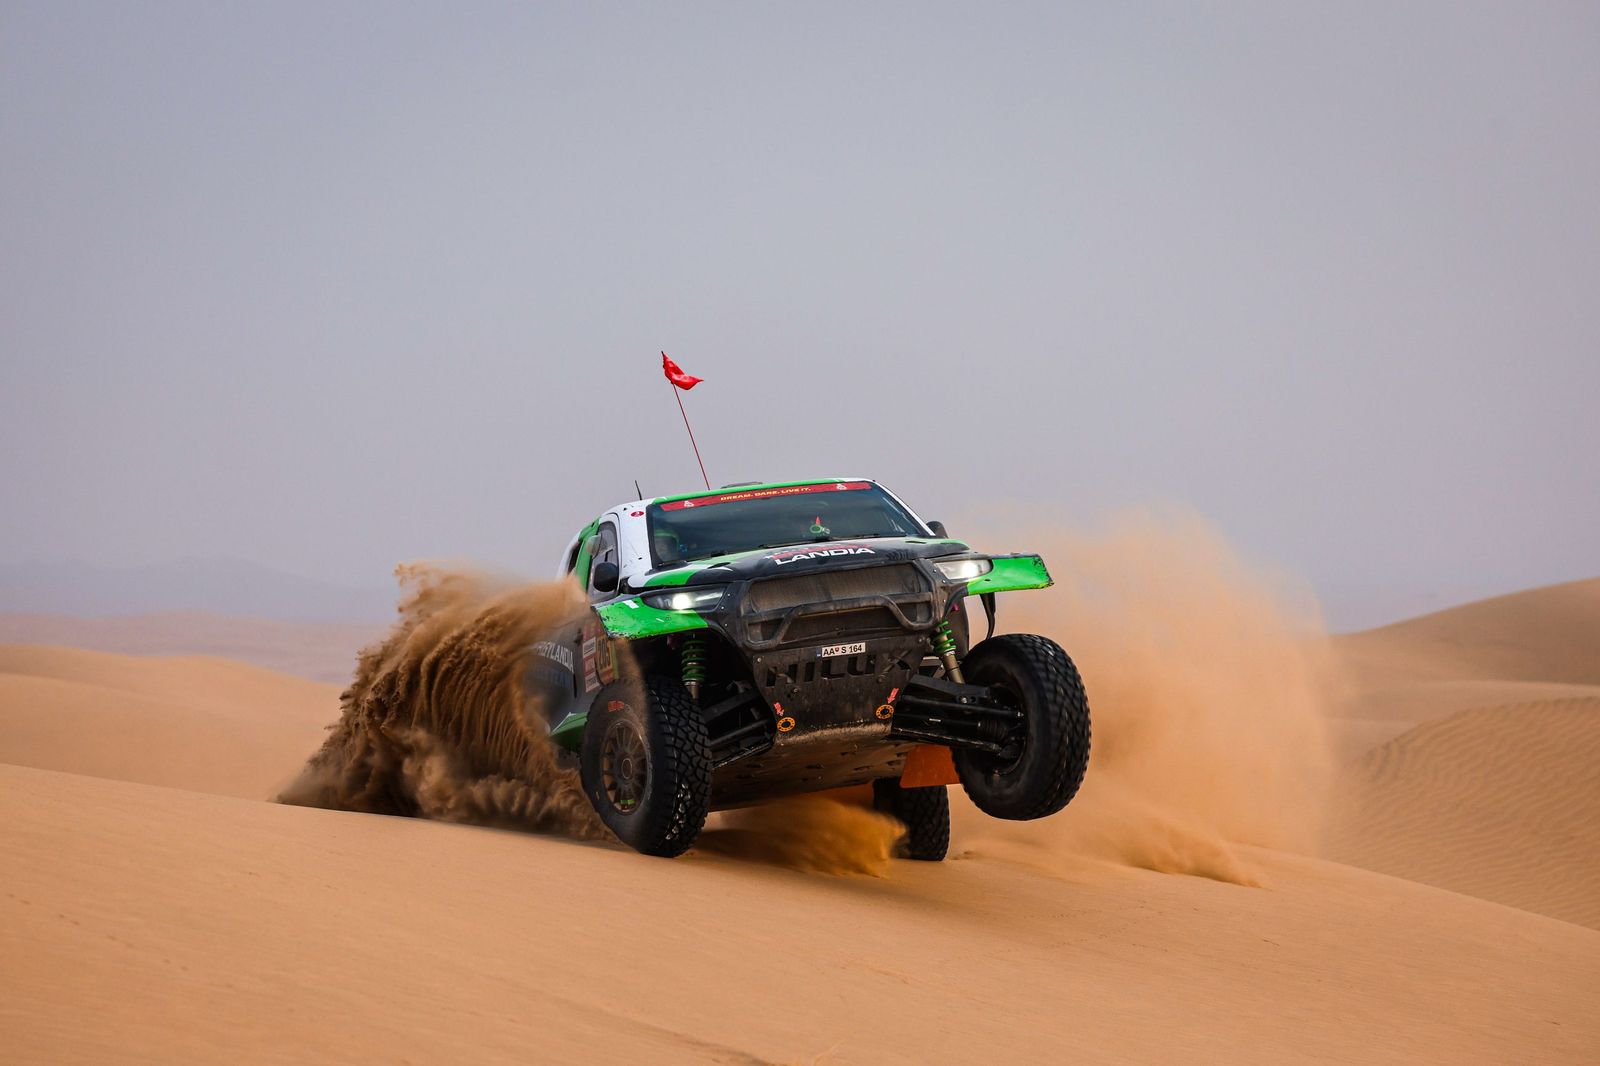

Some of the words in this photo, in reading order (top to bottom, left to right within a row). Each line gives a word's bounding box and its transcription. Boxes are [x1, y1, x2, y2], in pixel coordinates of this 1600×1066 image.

[720, 493, 754, 501] DREAM.
[774, 547, 876, 565] LANDIA
[823, 648, 835, 656] AA
[841, 646, 847, 654] S
[848, 644, 863, 653] 164
[766, 649, 912, 687] HILUX
